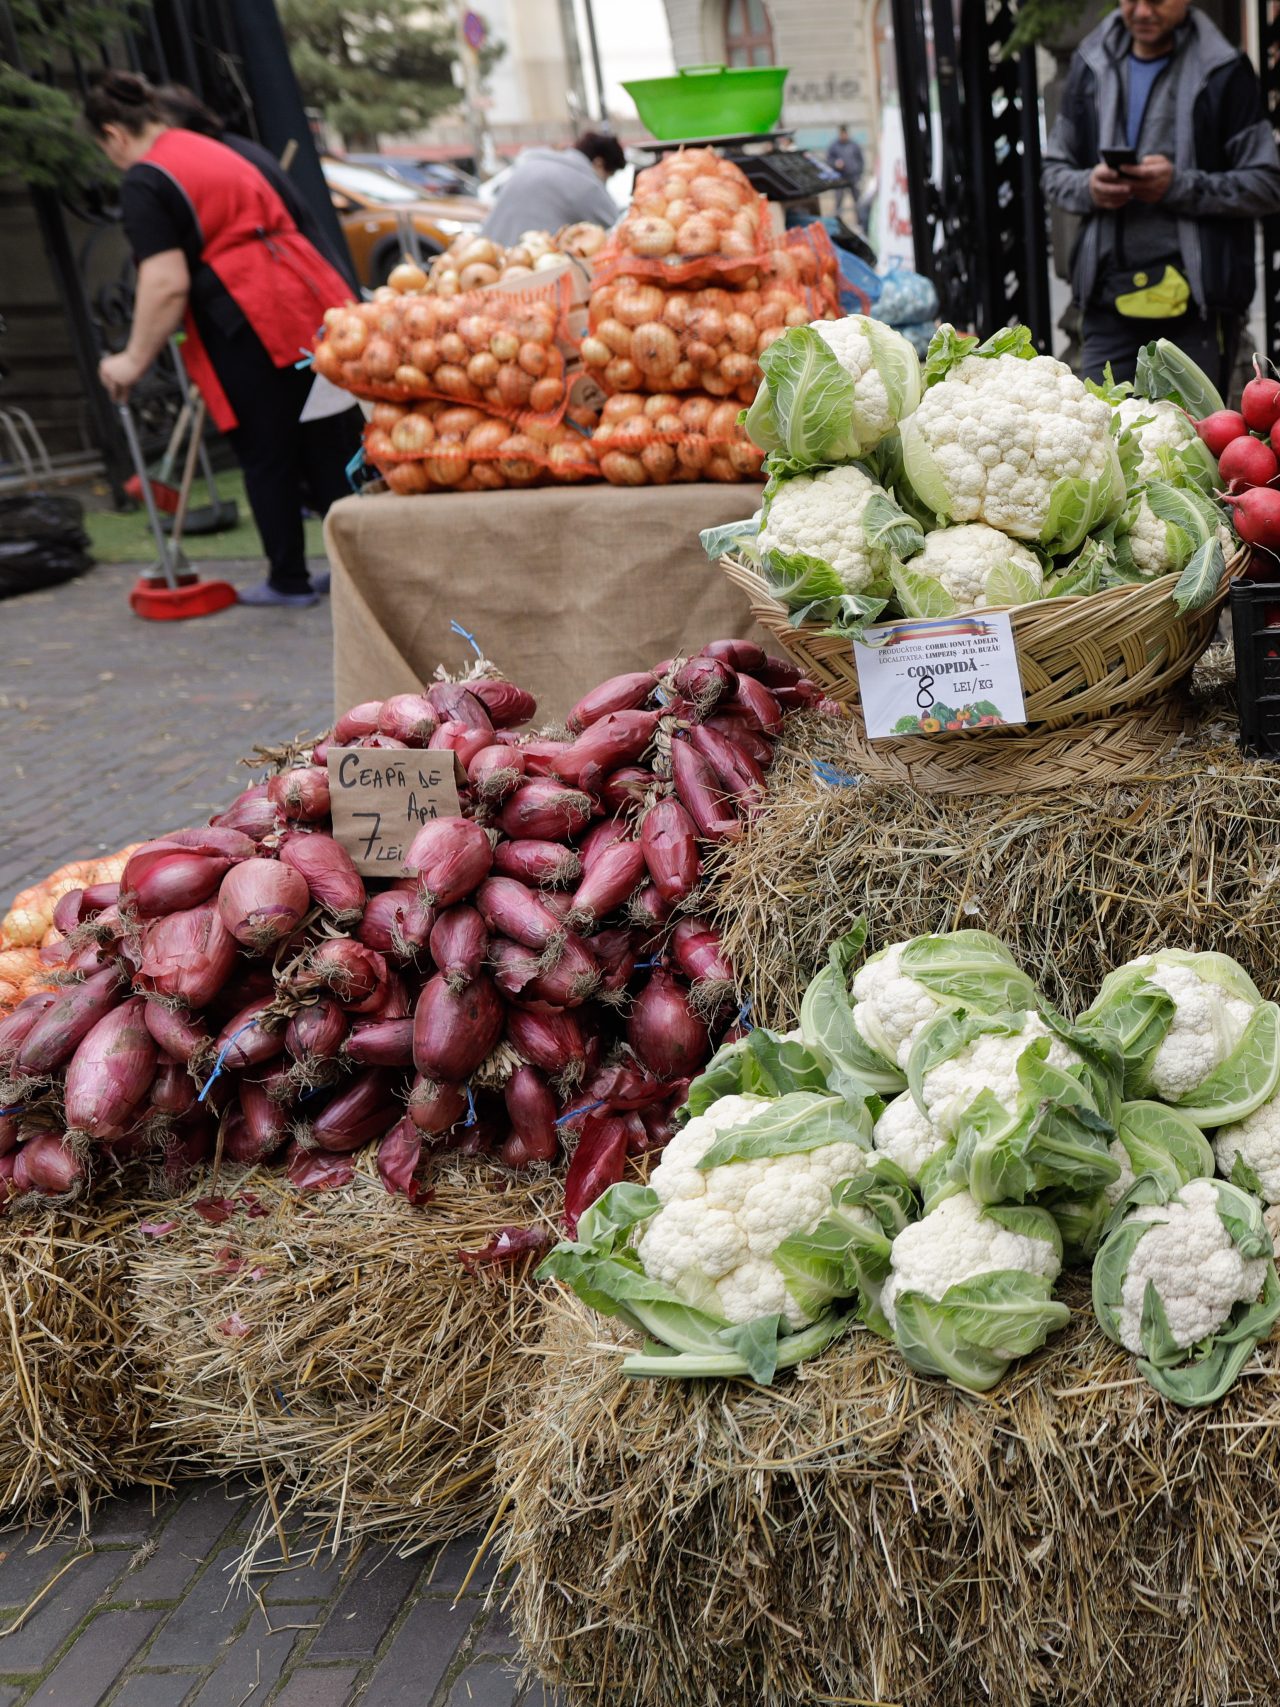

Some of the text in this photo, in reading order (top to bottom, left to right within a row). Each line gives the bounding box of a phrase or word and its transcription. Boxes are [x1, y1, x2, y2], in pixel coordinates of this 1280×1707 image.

[907, 658, 978, 678] CONOPIDĂ
[916, 675, 994, 709] 8 LEI/KG
[418, 770, 443, 789] DE
